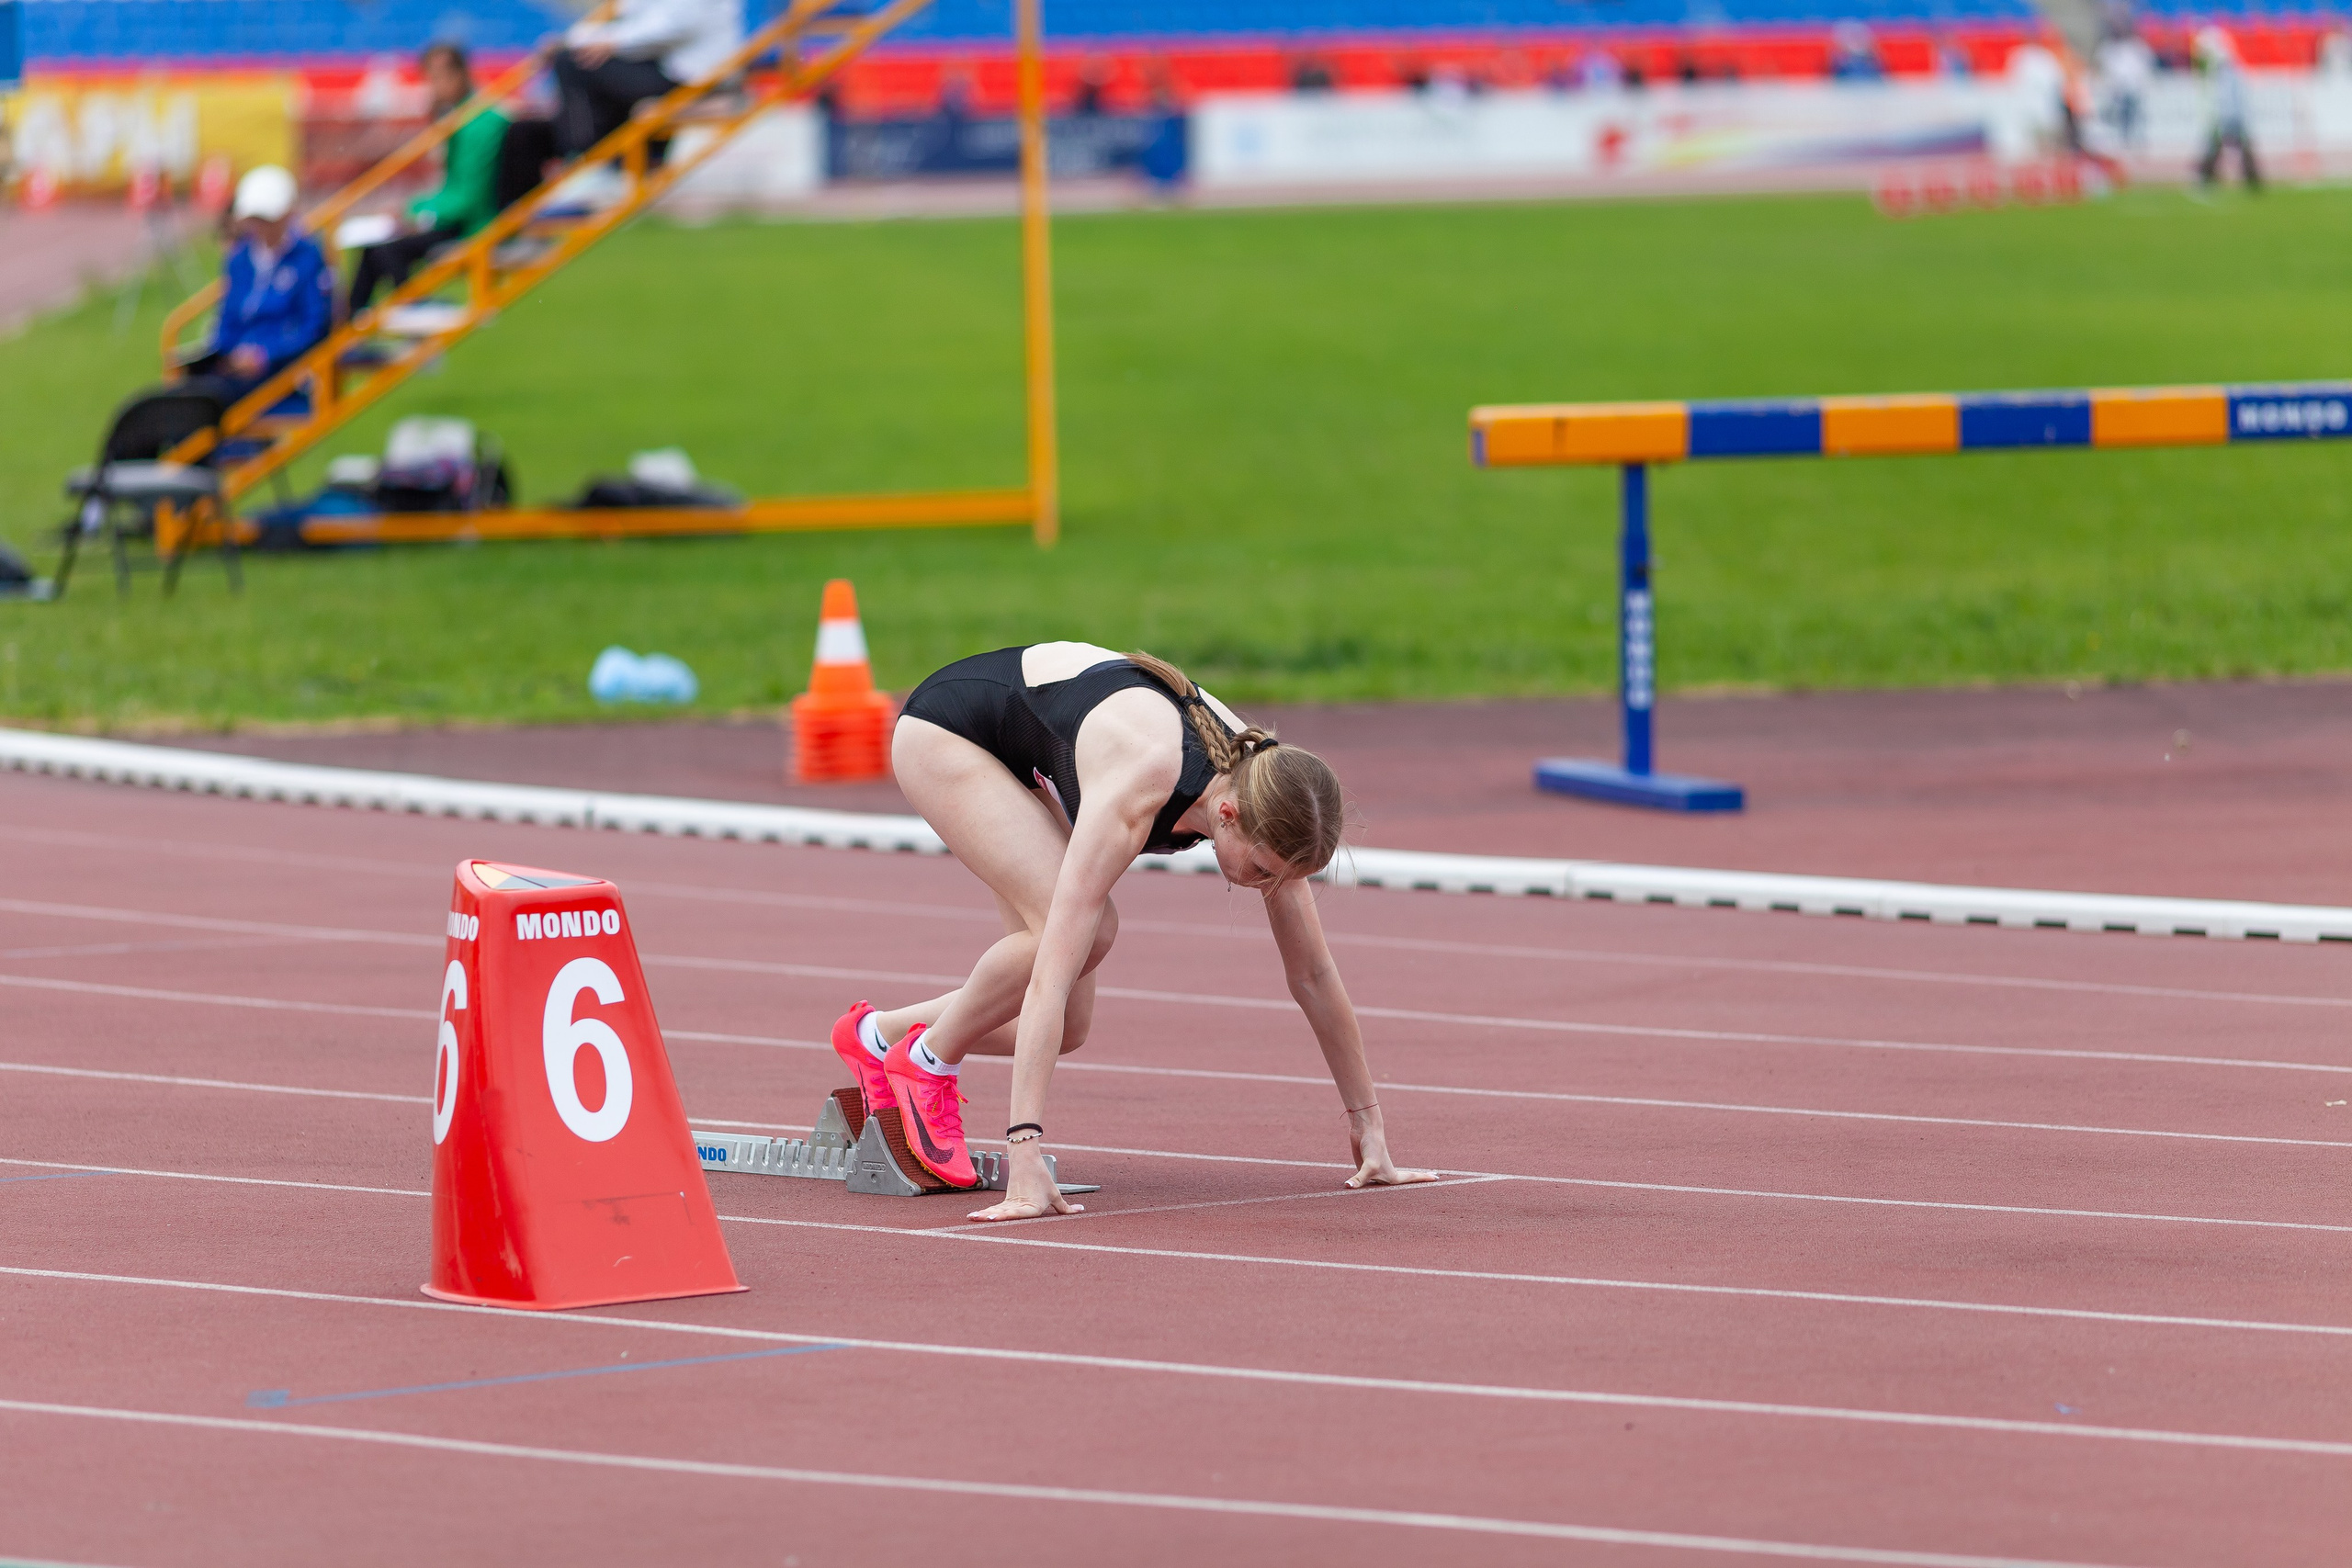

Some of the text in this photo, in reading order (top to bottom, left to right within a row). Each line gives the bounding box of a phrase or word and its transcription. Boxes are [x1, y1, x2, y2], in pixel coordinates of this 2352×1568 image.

[516, 908, 620, 941] MONDO
[433, 959, 468, 1145] 6
[542, 956, 634, 1143] 6
